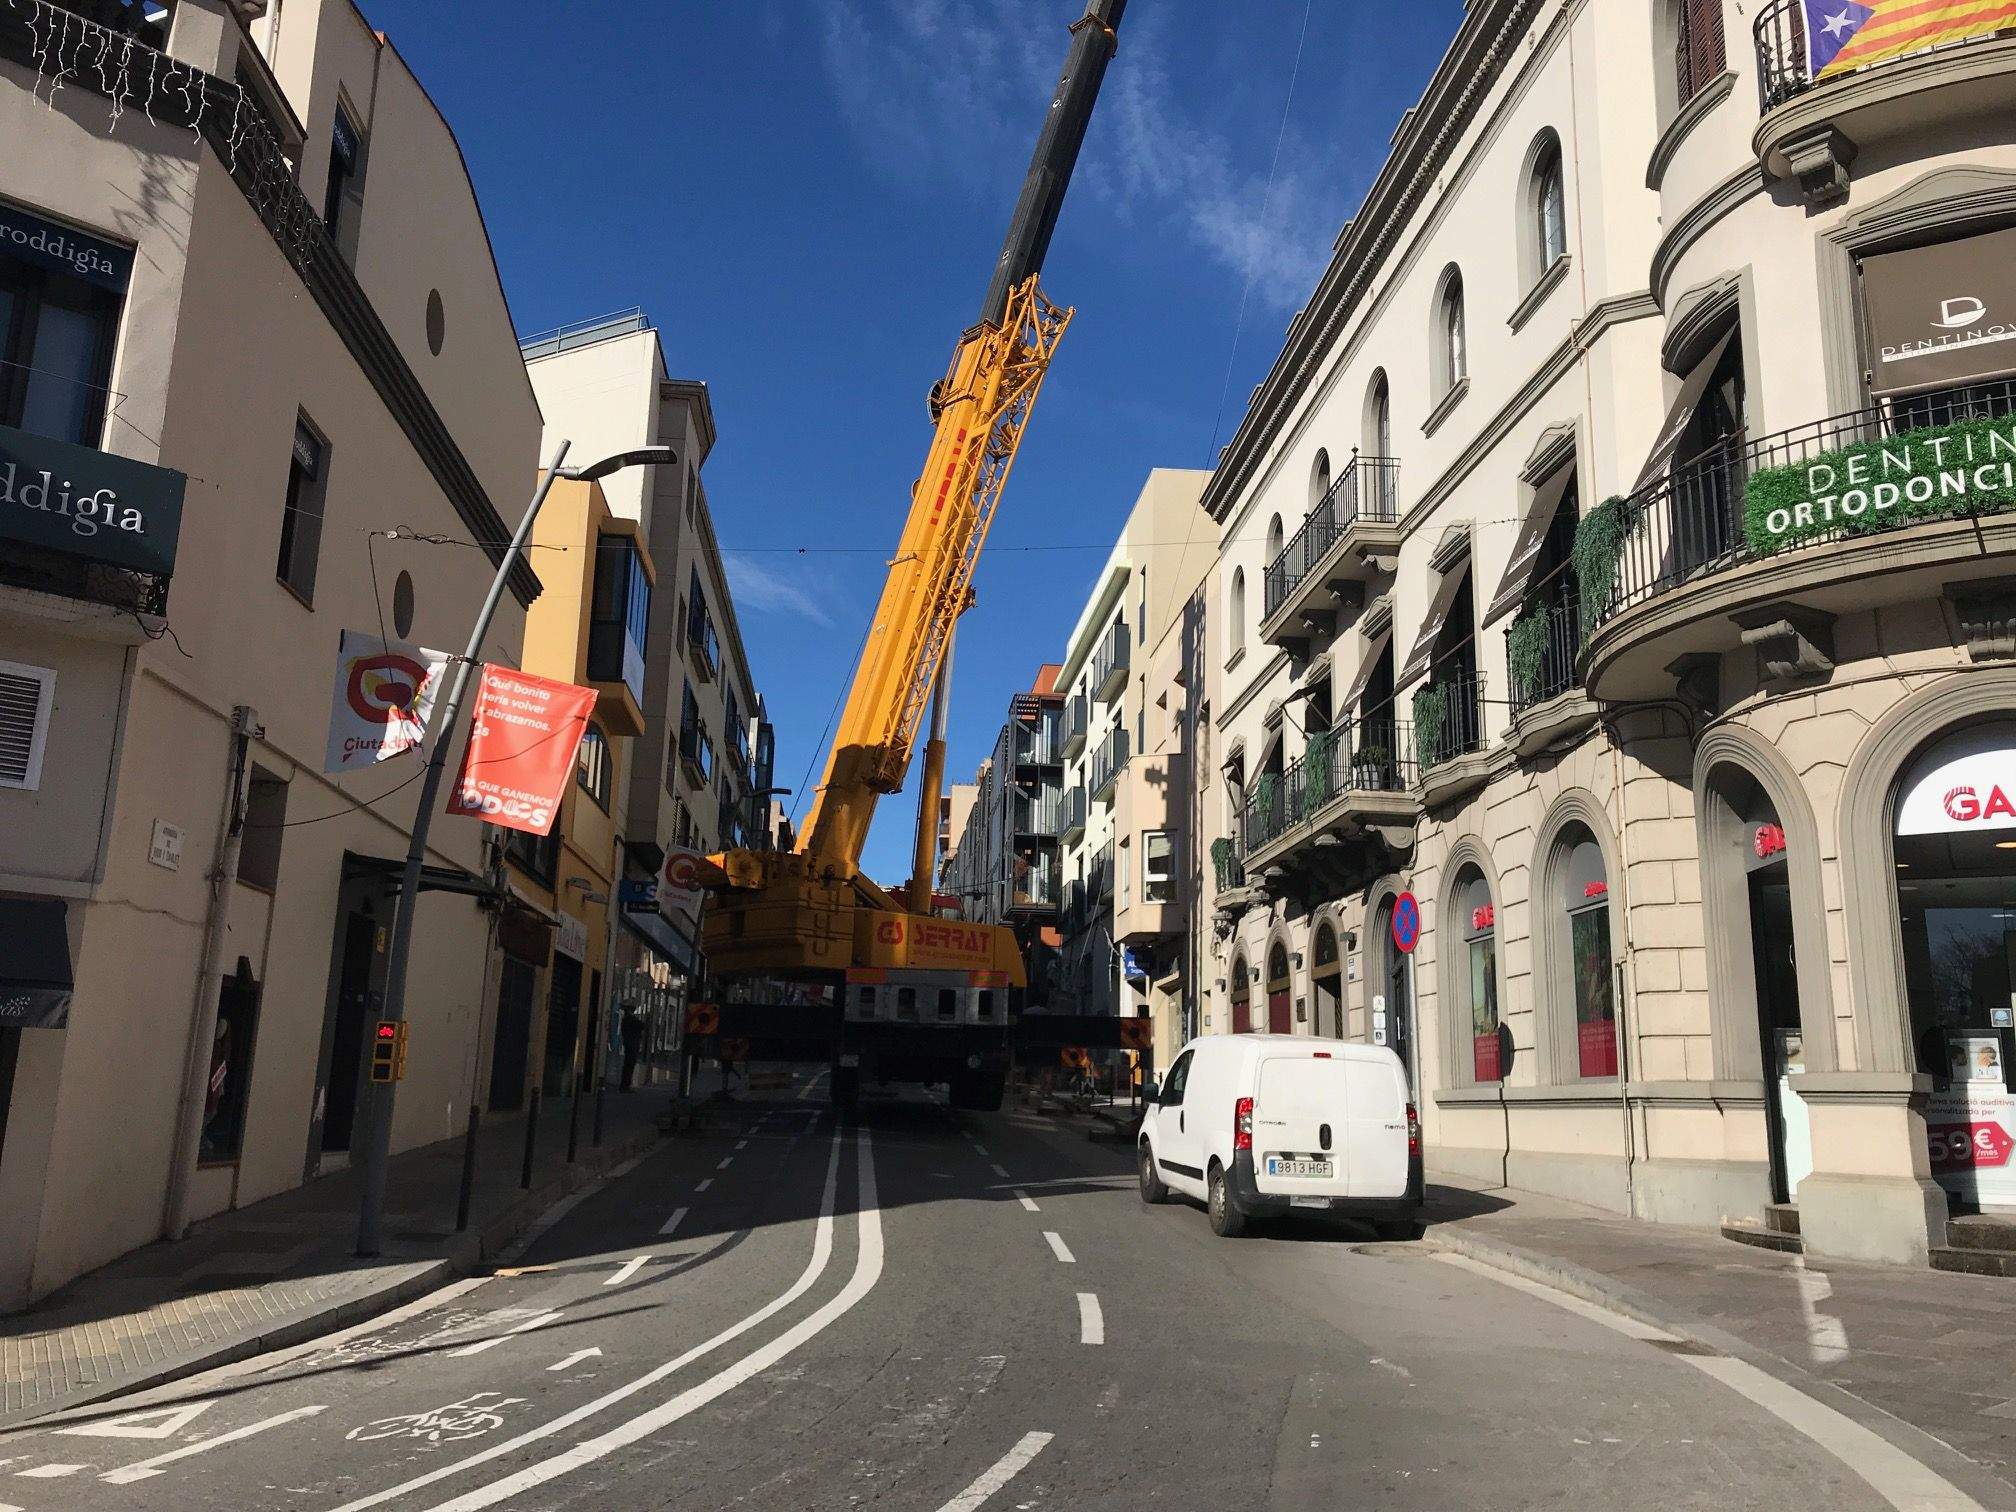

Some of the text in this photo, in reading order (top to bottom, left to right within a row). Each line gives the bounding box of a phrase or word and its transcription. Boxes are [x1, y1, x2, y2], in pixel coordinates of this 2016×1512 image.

[1808, 427, 2016, 495] DENTIN
[1766, 462, 2014, 534] ORTODONCI
[513, 682, 551, 701] bonito
[511, 698, 548, 715] volver
[486, 708, 552, 733] abrazarnos.
[478, 780, 500, 794] QUE
[501, 787, 554, 808] GANEMOS
[913, 923, 991, 953] SERRAT
[1980, 1097, 2015, 1107] auditiva
[1981, 1109, 1996, 1117] per
[1277, 1162, 1330, 1174] 9813 HGF
